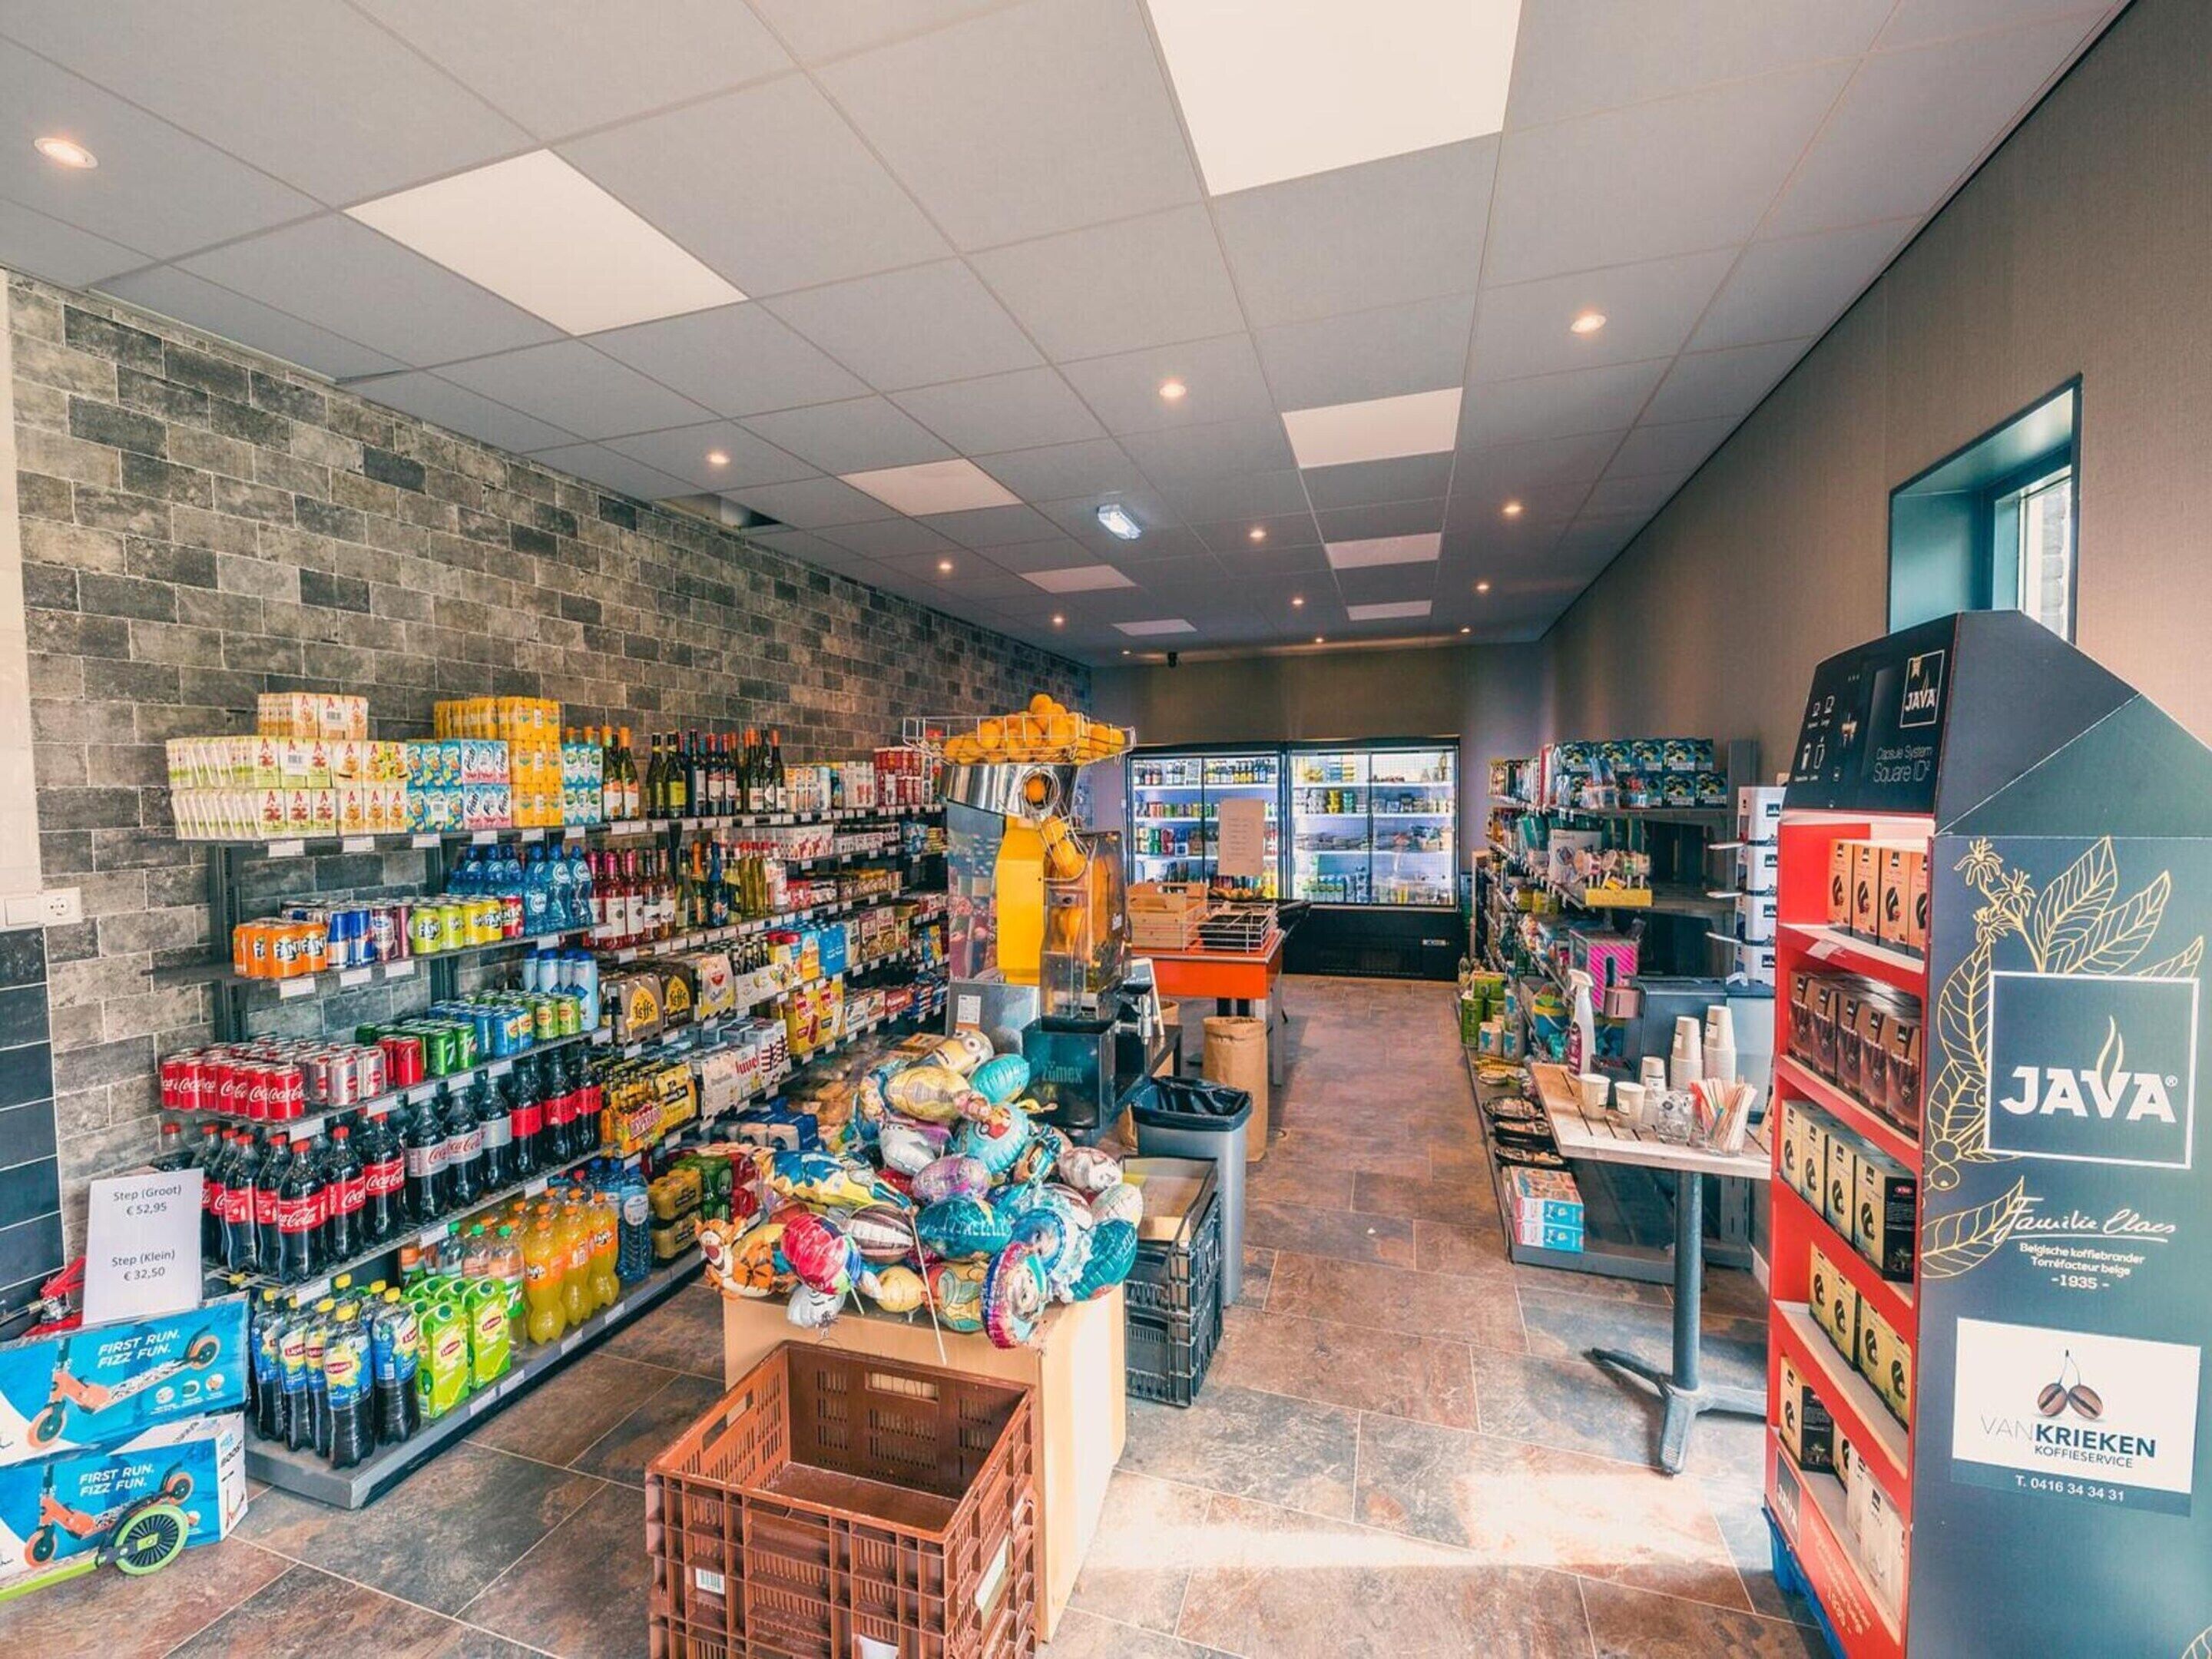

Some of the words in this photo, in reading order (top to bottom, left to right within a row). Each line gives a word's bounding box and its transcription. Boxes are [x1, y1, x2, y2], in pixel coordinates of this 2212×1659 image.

[1905, 688, 1936, 712] JAVA
[1876, 747, 1902, 760] Capsule
[1905, 745, 1932, 760] System
[1873, 762, 1912, 783] Square
[114, 1191, 139, 1201] Step
[142, 1184, 182, 1198] (Groot)
[127, 1206, 134, 1215] €
[136, 1202, 167, 1214] 52,95
[111, 1257, 137, 1267] Step
[140, 1249, 175, 1264] (Klein)
[2020, 1243, 2069, 1257] Belgische
[2070, 1247, 2145, 1264] koffiebrander
[124, 1271, 131, 1281] €
[134, 1267, 165, 1280] 32,50
[2031, 1256, 2099, 1271] Torréfacteur
[2101, 1264, 2131, 1278] belge
[98, 1336, 143, 1356] FIRST
[146, 1329, 180, 1345] RUN.
[98, 1352, 131, 1369] FIZZ
[137, 1343, 171, 1359] FUN.
[2034, 1444, 2134, 1469] KOFFIESERVICE
[79, 1469, 119, 1485] FIRST
[123, 1463, 154, 1478] RUN.
[80, 1483, 111, 1497] FIZZ
[116, 1476, 147, 1492] FUN.
[2015, 1475, 2026, 1488] T.
[2031, 1477, 2064, 1493] 0416
[2068, 1484, 2084, 1496] 34
[2088, 1486, 2104, 1498] 34
[2108, 1489, 2124, 1502] 31
